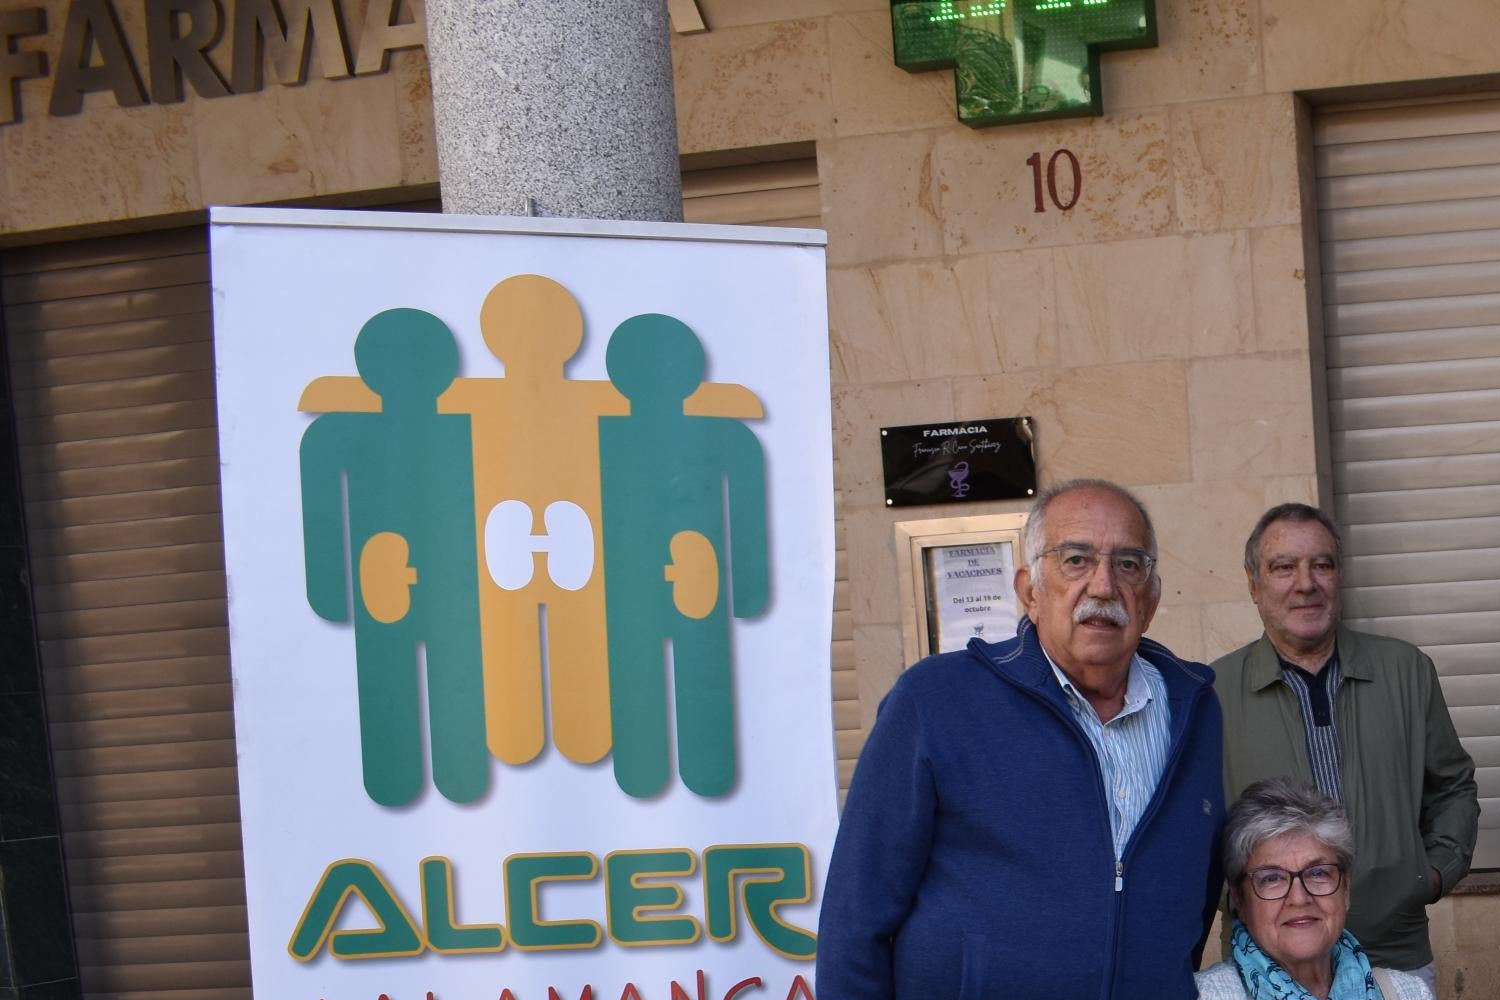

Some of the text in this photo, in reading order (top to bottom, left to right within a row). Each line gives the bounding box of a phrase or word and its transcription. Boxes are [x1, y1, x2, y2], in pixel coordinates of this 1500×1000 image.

[1026, 148, 1082, 213] 10
[923, 426, 988, 438] FARMACIA
[946, 568, 1002, 579] VACACIONES
[964, 605, 991, 613] octubre
[288, 842, 818, 961] ALCER
